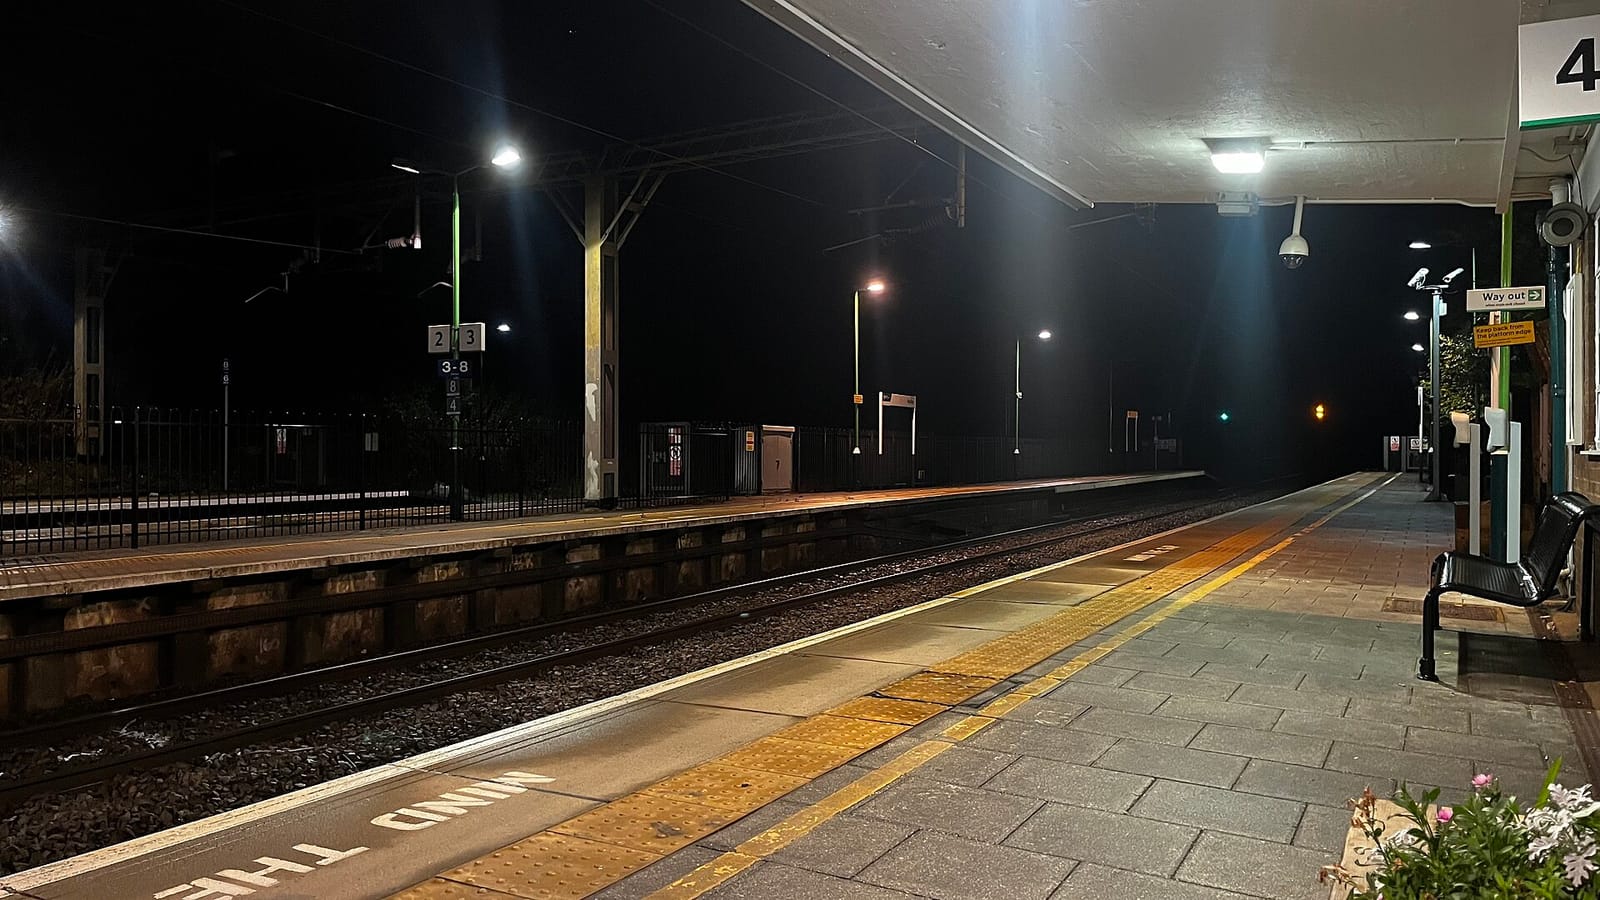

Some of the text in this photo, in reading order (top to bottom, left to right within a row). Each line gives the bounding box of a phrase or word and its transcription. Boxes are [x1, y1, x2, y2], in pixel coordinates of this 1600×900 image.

[1556, 38, 1600, 91] 4
[1483, 292, 1526, 302] Way out
[435, 331, 443, 346] 2
[466, 330, 475, 344] 3
[442, 361, 468, 373] 3-8
[450, 380, 456, 392] 8
[450, 399, 457, 411] 4
[370, 771, 557, 831] MIND
